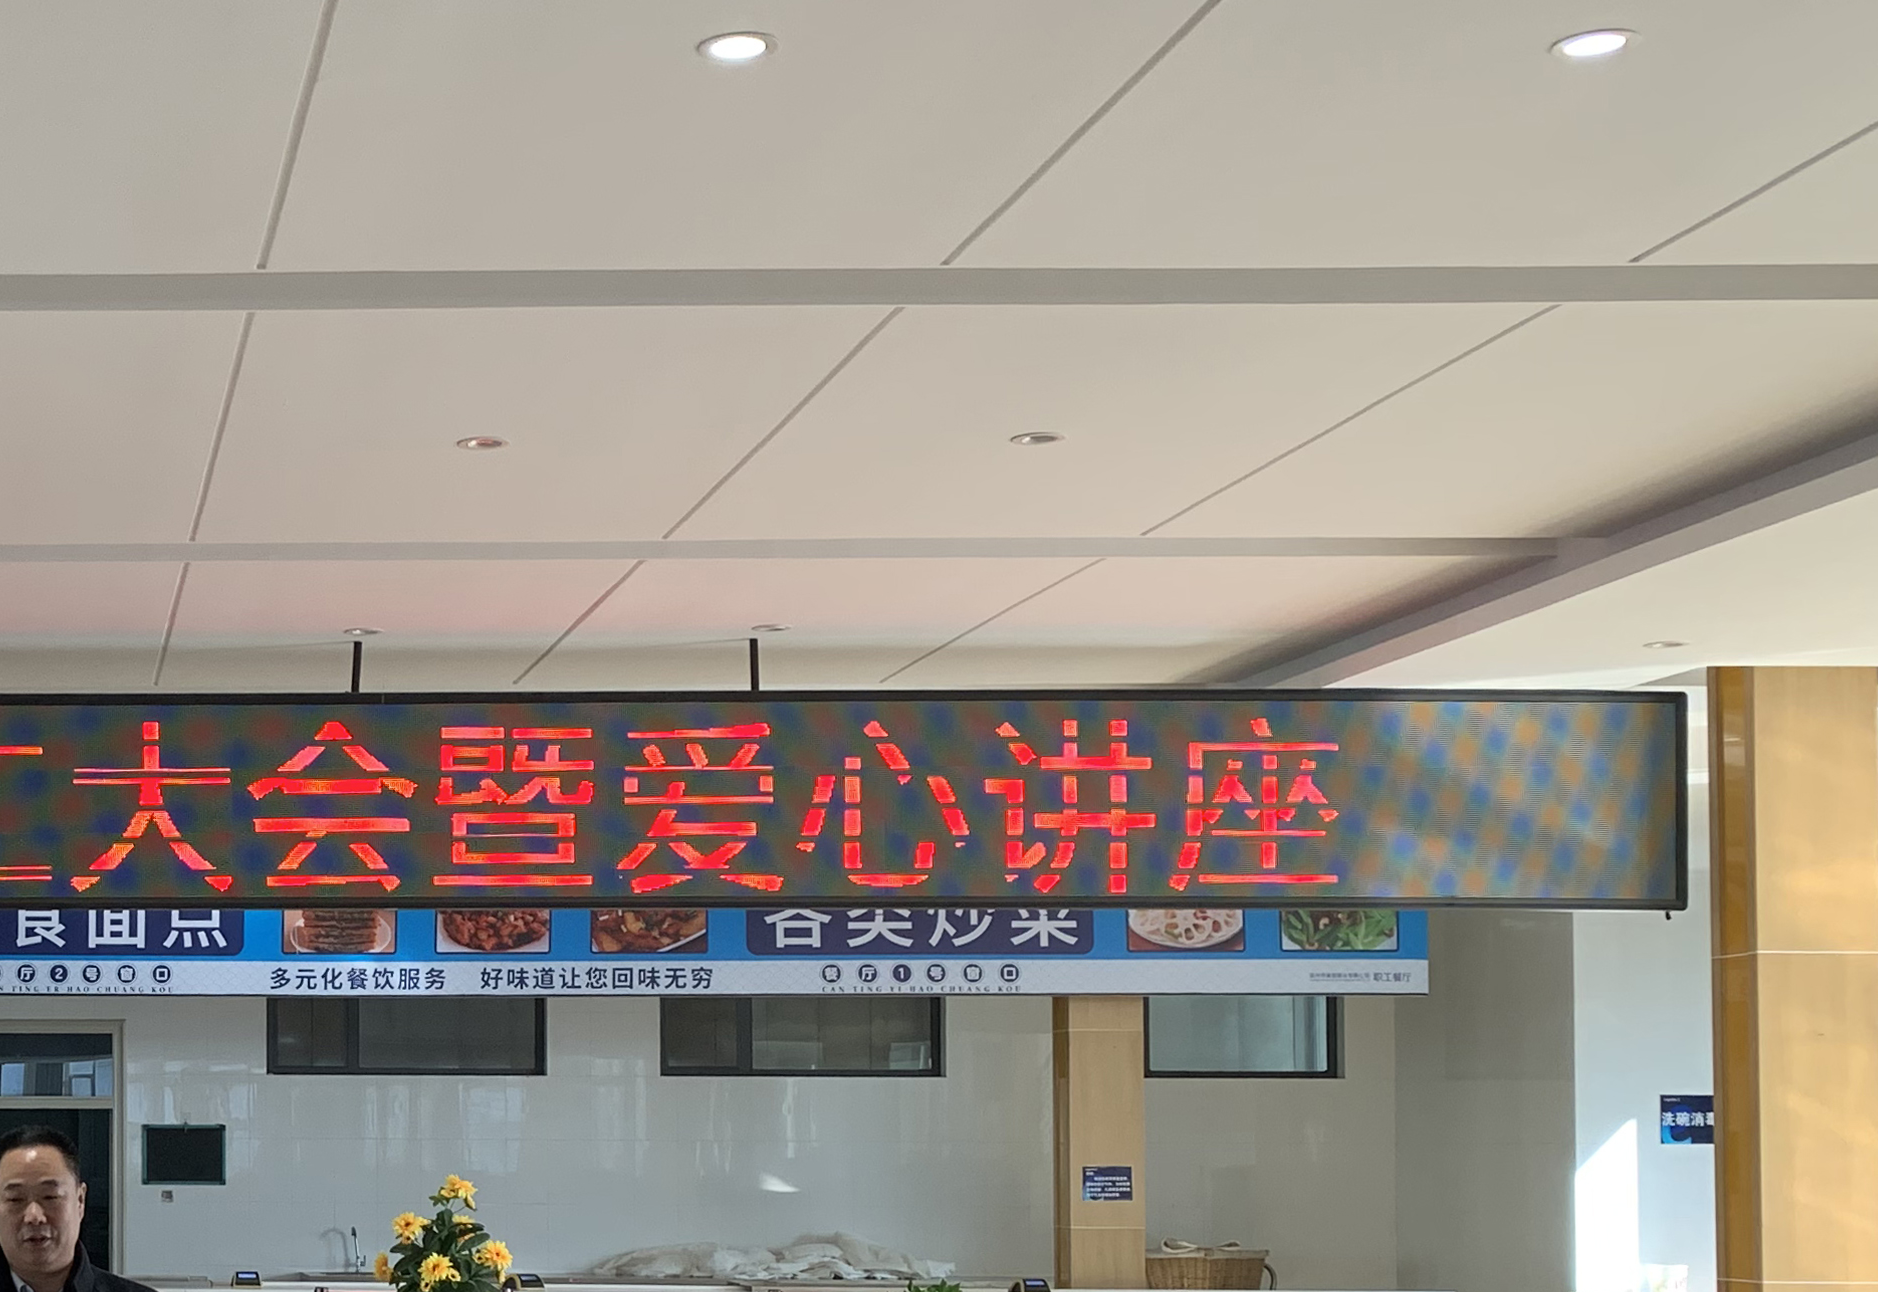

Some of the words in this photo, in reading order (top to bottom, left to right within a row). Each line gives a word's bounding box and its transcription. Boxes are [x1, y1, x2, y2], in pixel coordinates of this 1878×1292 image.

[269, 966, 447, 991] 多元化餐饮服务
[480, 966, 714, 990] 好味道让您回味无穷
